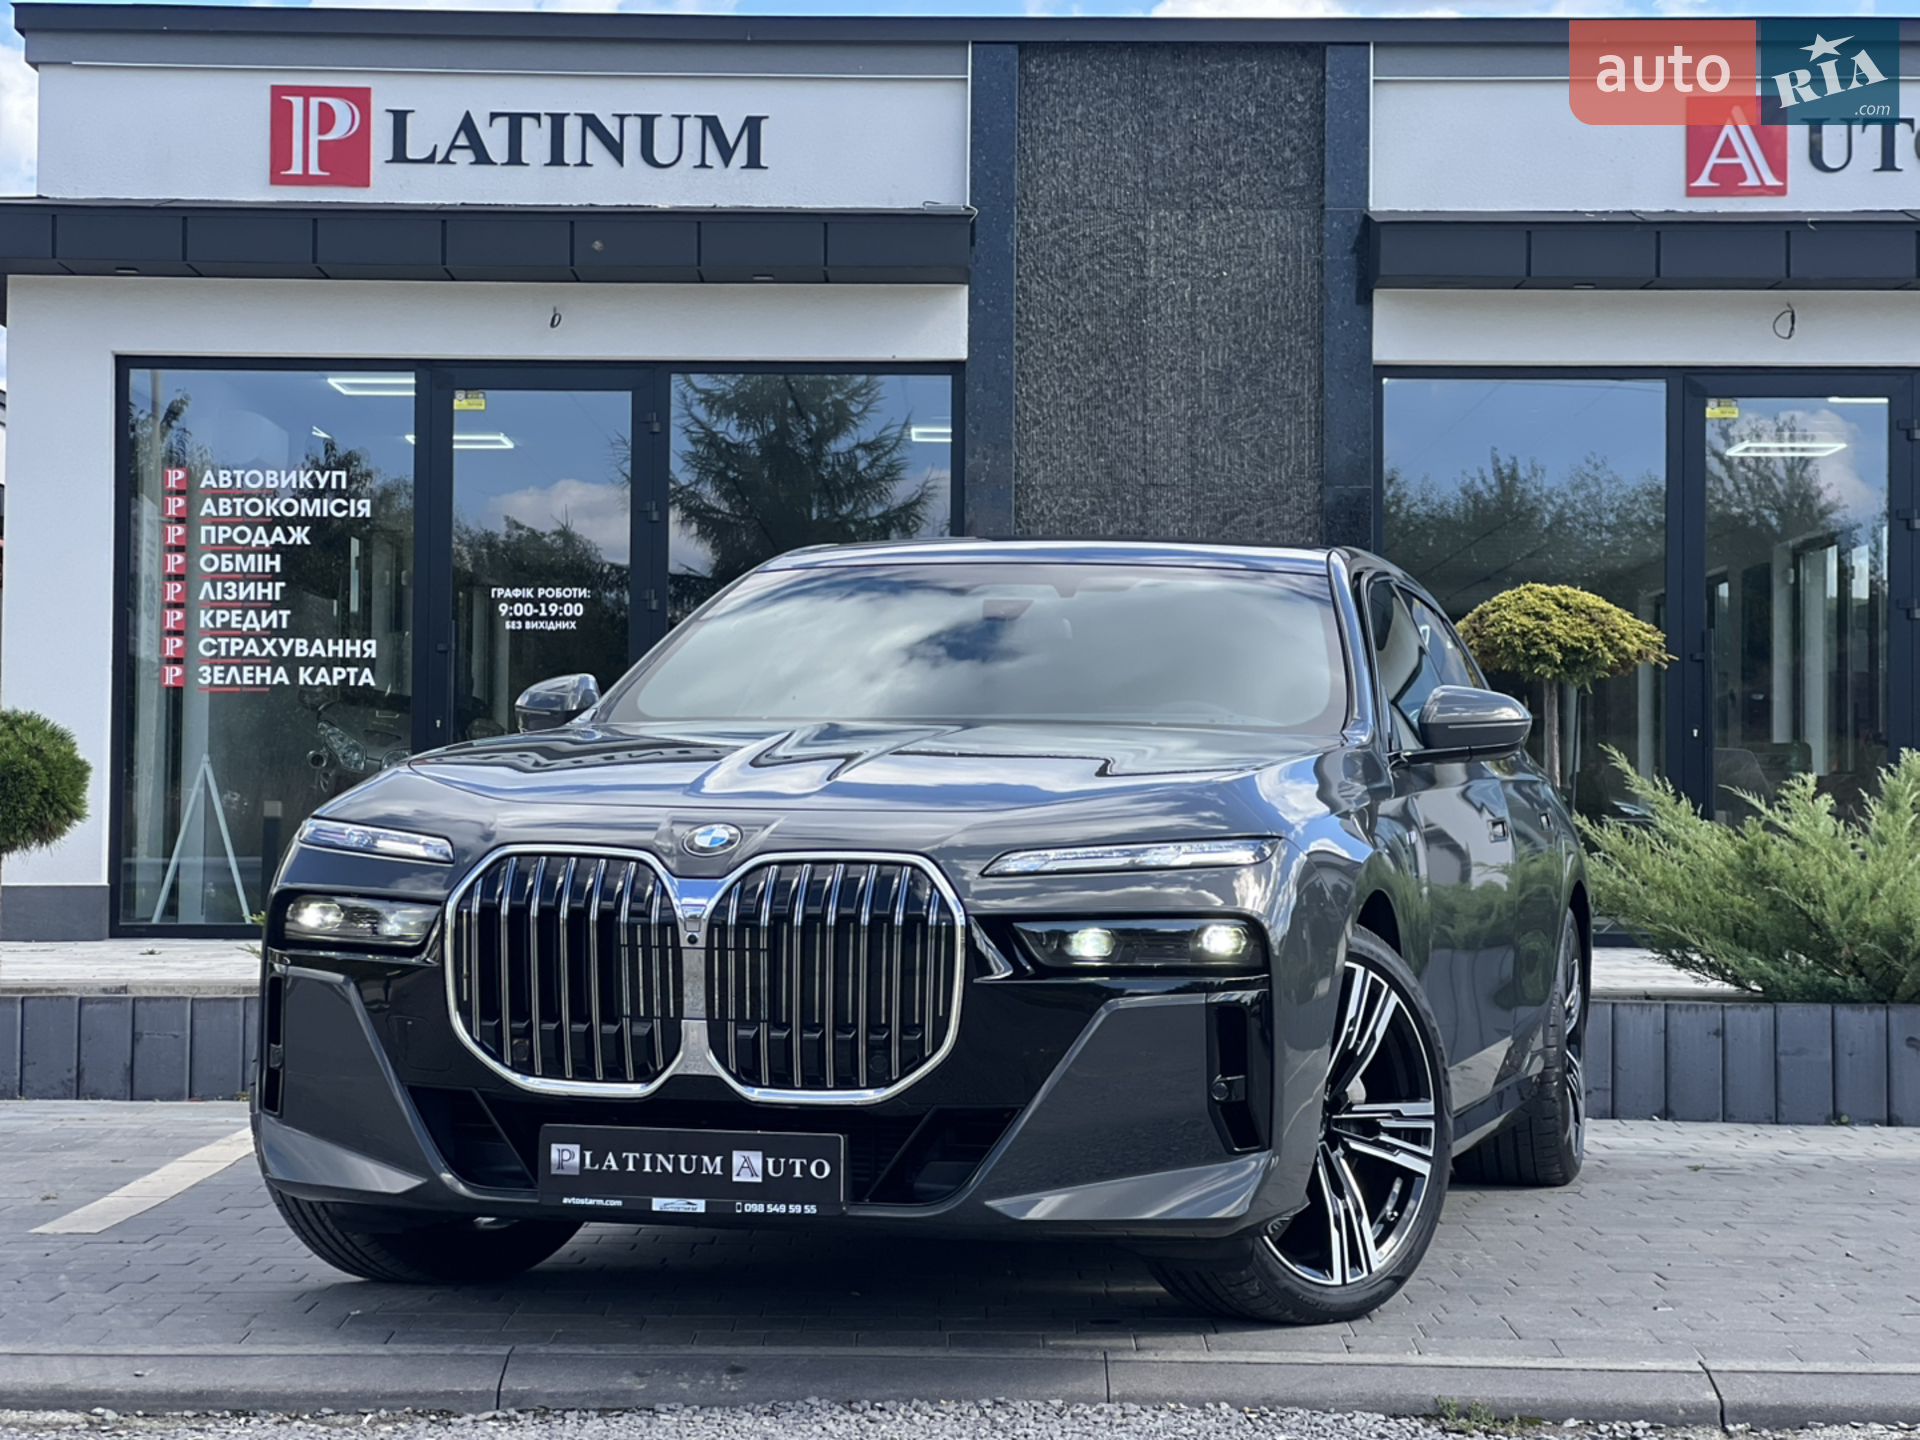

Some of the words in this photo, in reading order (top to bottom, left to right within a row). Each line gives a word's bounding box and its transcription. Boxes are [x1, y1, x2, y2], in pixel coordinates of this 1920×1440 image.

[280, 95, 769, 177] PLATINUM
[1689, 105, 1920, 187] AUT
[200, 470, 347, 489] АВТОВИКУП
[200, 498, 371, 518] АВТОКОМІСІЯ
[200, 526, 311, 547] ПРОДАЖ
[200, 554, 281, 573] ОБМІН
[199, 582, 286, 601] ЛІЗИНГ
[491, 588, 534, 598] ГРАФІК
[538, 588, 591, 598] РОБОТИ:
[498, 603, 584, 617] 9:00-19:00
[199, 610, 291, 631] КРЕДИТ
[505, 621, 522, 630] БЕЗ
[525, 621, 577, 631] ВИХІДНИХ
[198, 638, 377, 658] СТРАХУВАННЯ
[198, 666, 290, 685] ЗЕЛЕНА
[299, 667, 376, 686] КАРТА
[556, 1148, 723, 1175] PLATINUM
[736, 1155, 831, 1179] AUTO
[744, 1203, 765, 1213] 098
[766, 1203, 786, 1213] 549
[788, 1204, 802, 1214] 59
[803, 1204, 817, 1214] 55
